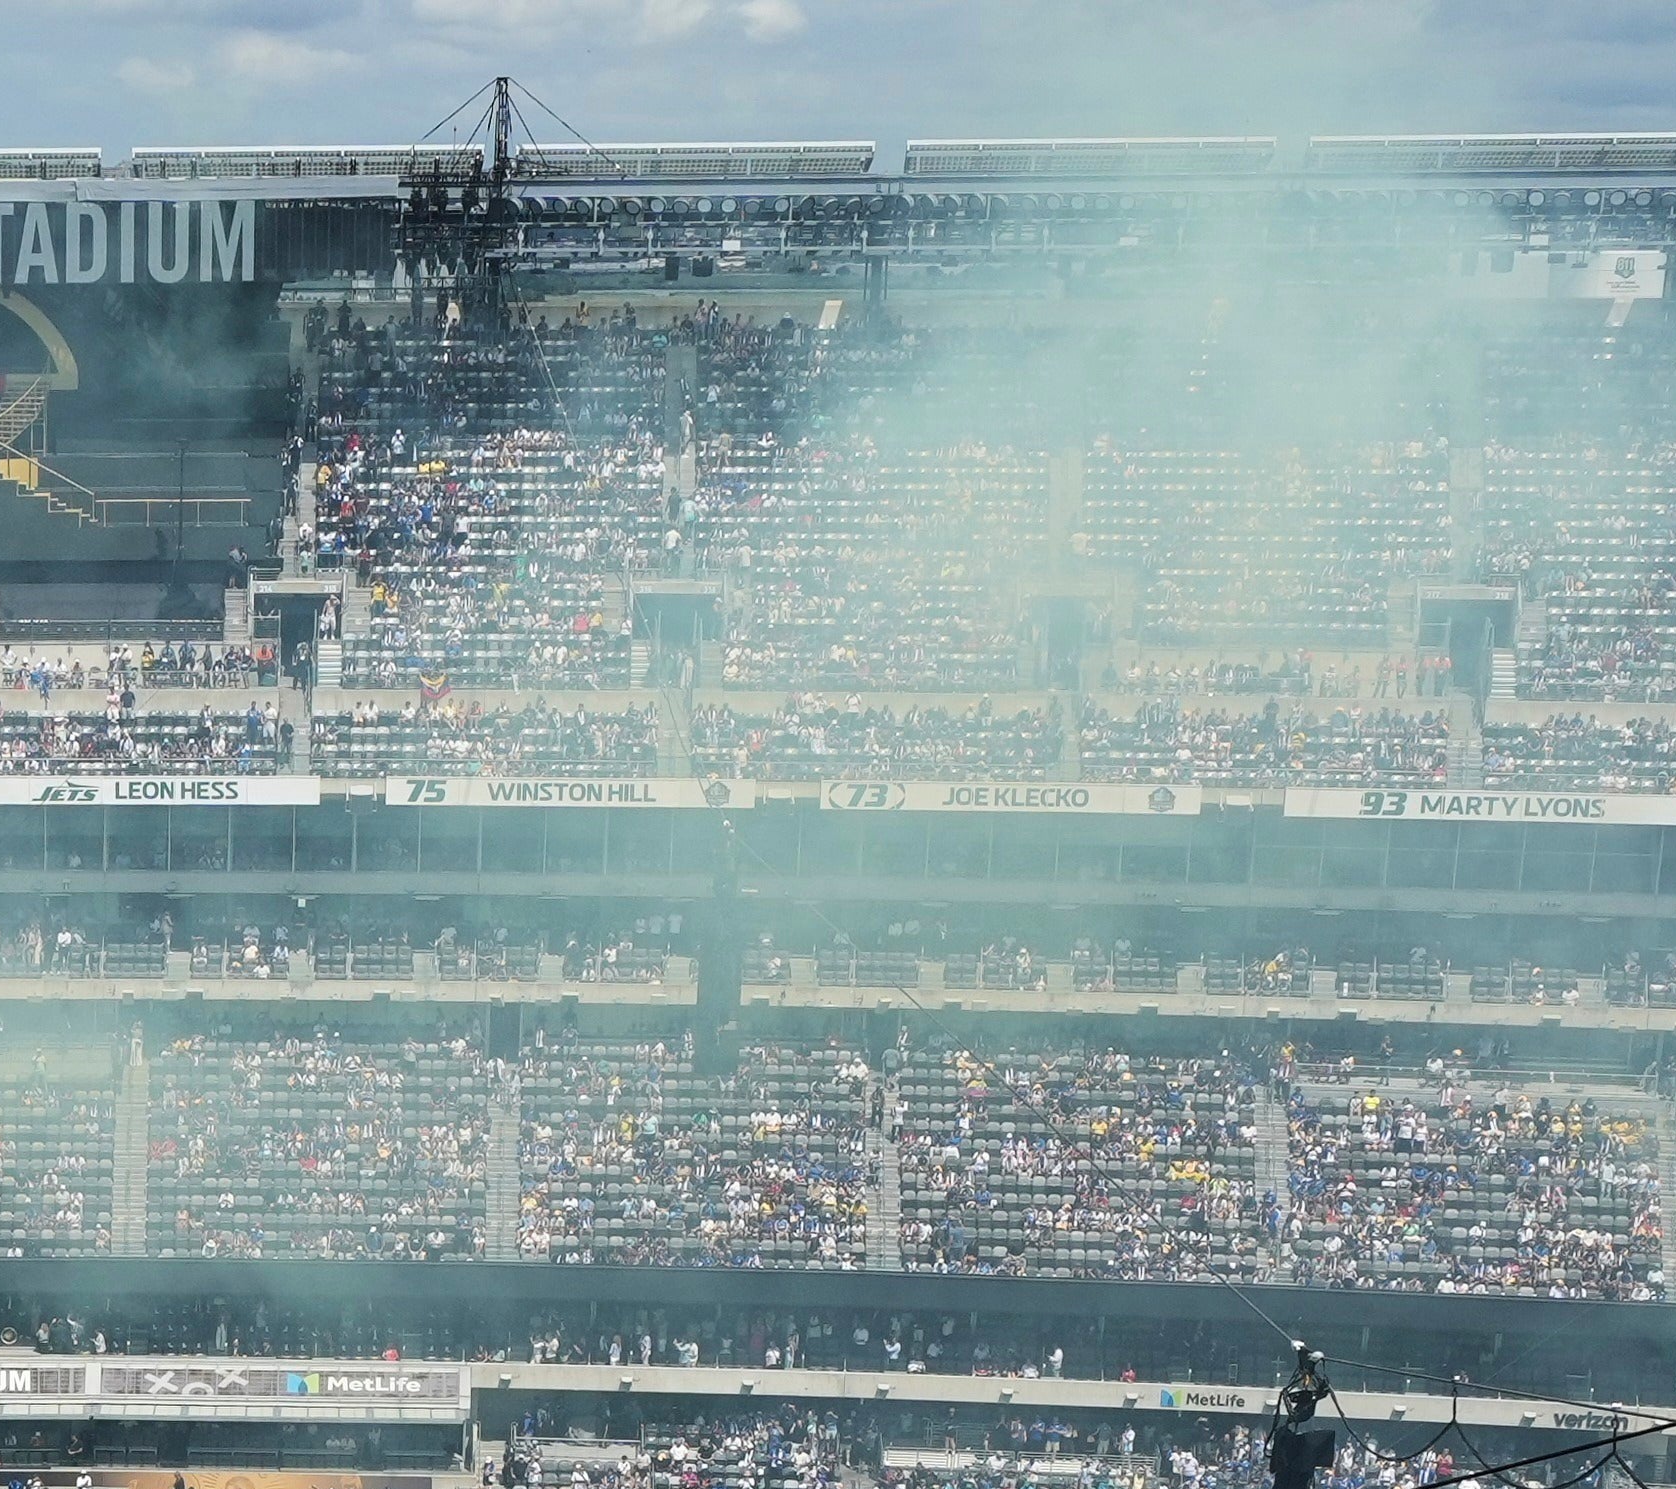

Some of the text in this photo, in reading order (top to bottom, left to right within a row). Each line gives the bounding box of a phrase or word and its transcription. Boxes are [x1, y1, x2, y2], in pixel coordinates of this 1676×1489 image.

[32, 781, 240, 802] JETS LEON HESS
[405, 780, 657, 803] 75 WINSTON HILL
[846, 783, 1089, 808] 73 JOE KLECKO
[1360, 792, 1606, 819] 93 MARTY LYONS
[327, 1375, 422, 1392] MetLife
[1186, 1392, 1246, 1408] MetLife
[1553, 1411, 1629, 1431] verizon
